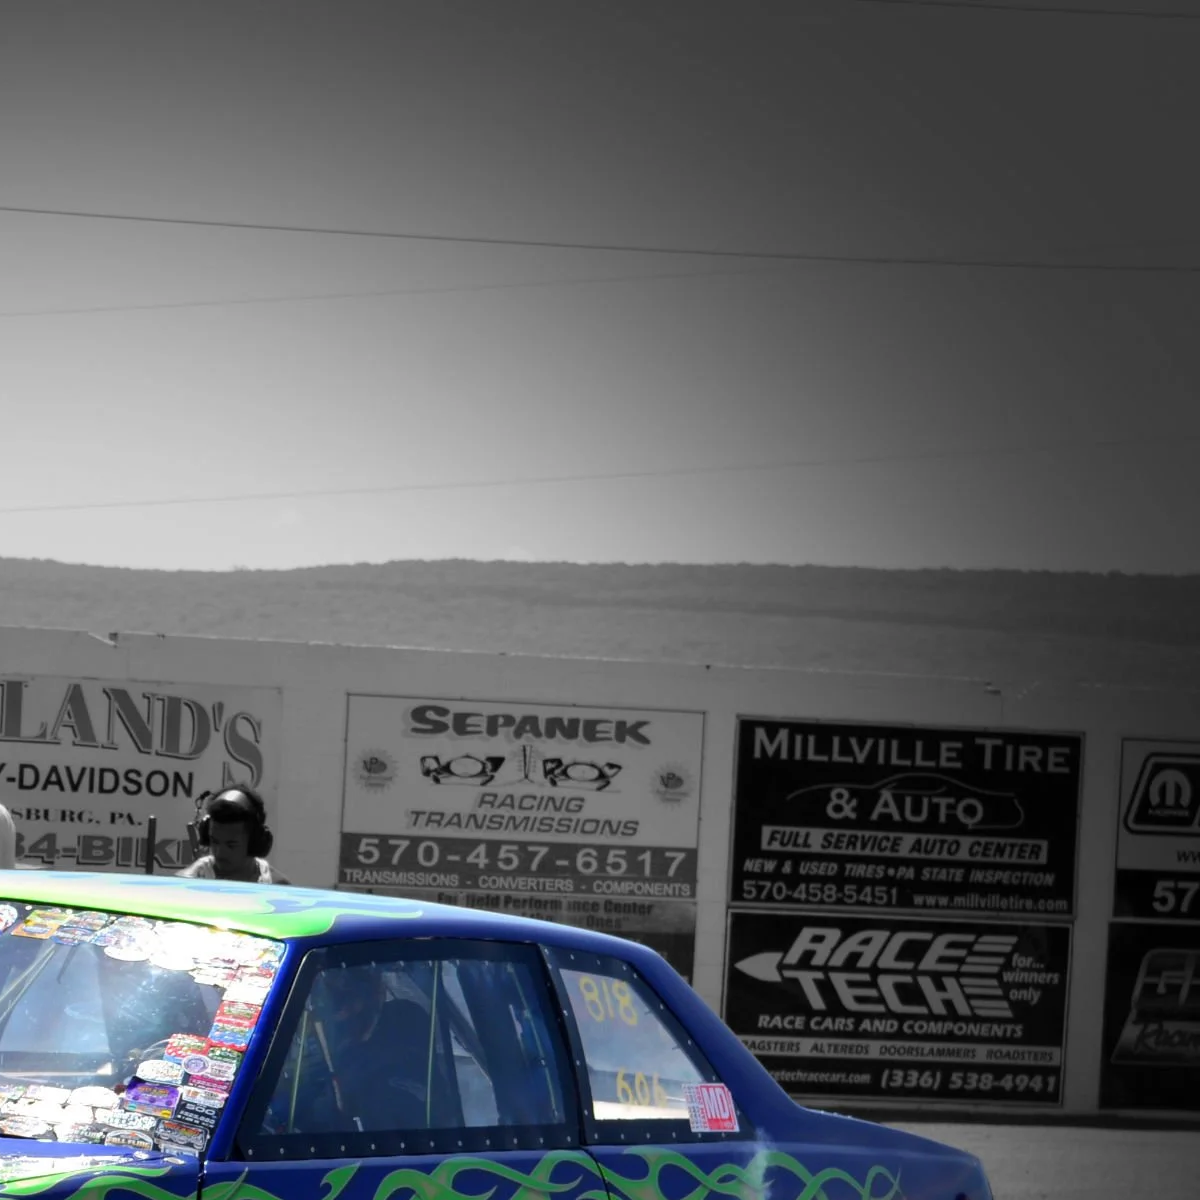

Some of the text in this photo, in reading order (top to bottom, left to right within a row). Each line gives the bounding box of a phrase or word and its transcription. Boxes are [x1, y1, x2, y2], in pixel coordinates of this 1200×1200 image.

[406, 704, 652, 746] SEPANEK
[753, 727, 1072, 774] MILLVILLE TIRE
[477, 792, 586, 814] RACING
[826, 787, 984, 826] & AUTO
[408, 809, 641, 838] TRANSMISSIONS
[357, 837, 687, 878] 570-457-6517
[766, 829, 1043, 862] FULL SERVICE AUTO CENTER
[344, 868, 691, 898] TRANSMISSIONS CONVERTERS COMPONENTS
[742, 858, 776, 873] NEW
[799, 862, 837, 877] USED
[921, 868, 965, 883] STATE
[969, 870, 1055, 887] INSPECTION
[604, 899, 655, 915] Center
[742, 880, 1068, 912] 570-458-5451 www.millvilletire.com
[782, 926, 982, 973] RACE
[781, 969, 978, 1017] TECH
[1002, 970, 1060, 986] winners
[578, 975, 639, 1026] 818
[1009, 988, 1041, 1006] only
[757, 1014, 1024, 1038] RACE CARS AND COMPONENTS
[810, 1041, 871, 1056] ALTEREDS
[878, 1044, 977, 1060] DOORSLAMMERS
[985, 1048, 1055, 1063] ROADSTERS
[881, 1068, 942, 1090] (336)
[948, 1072, 1057, 1094] 538-4941
